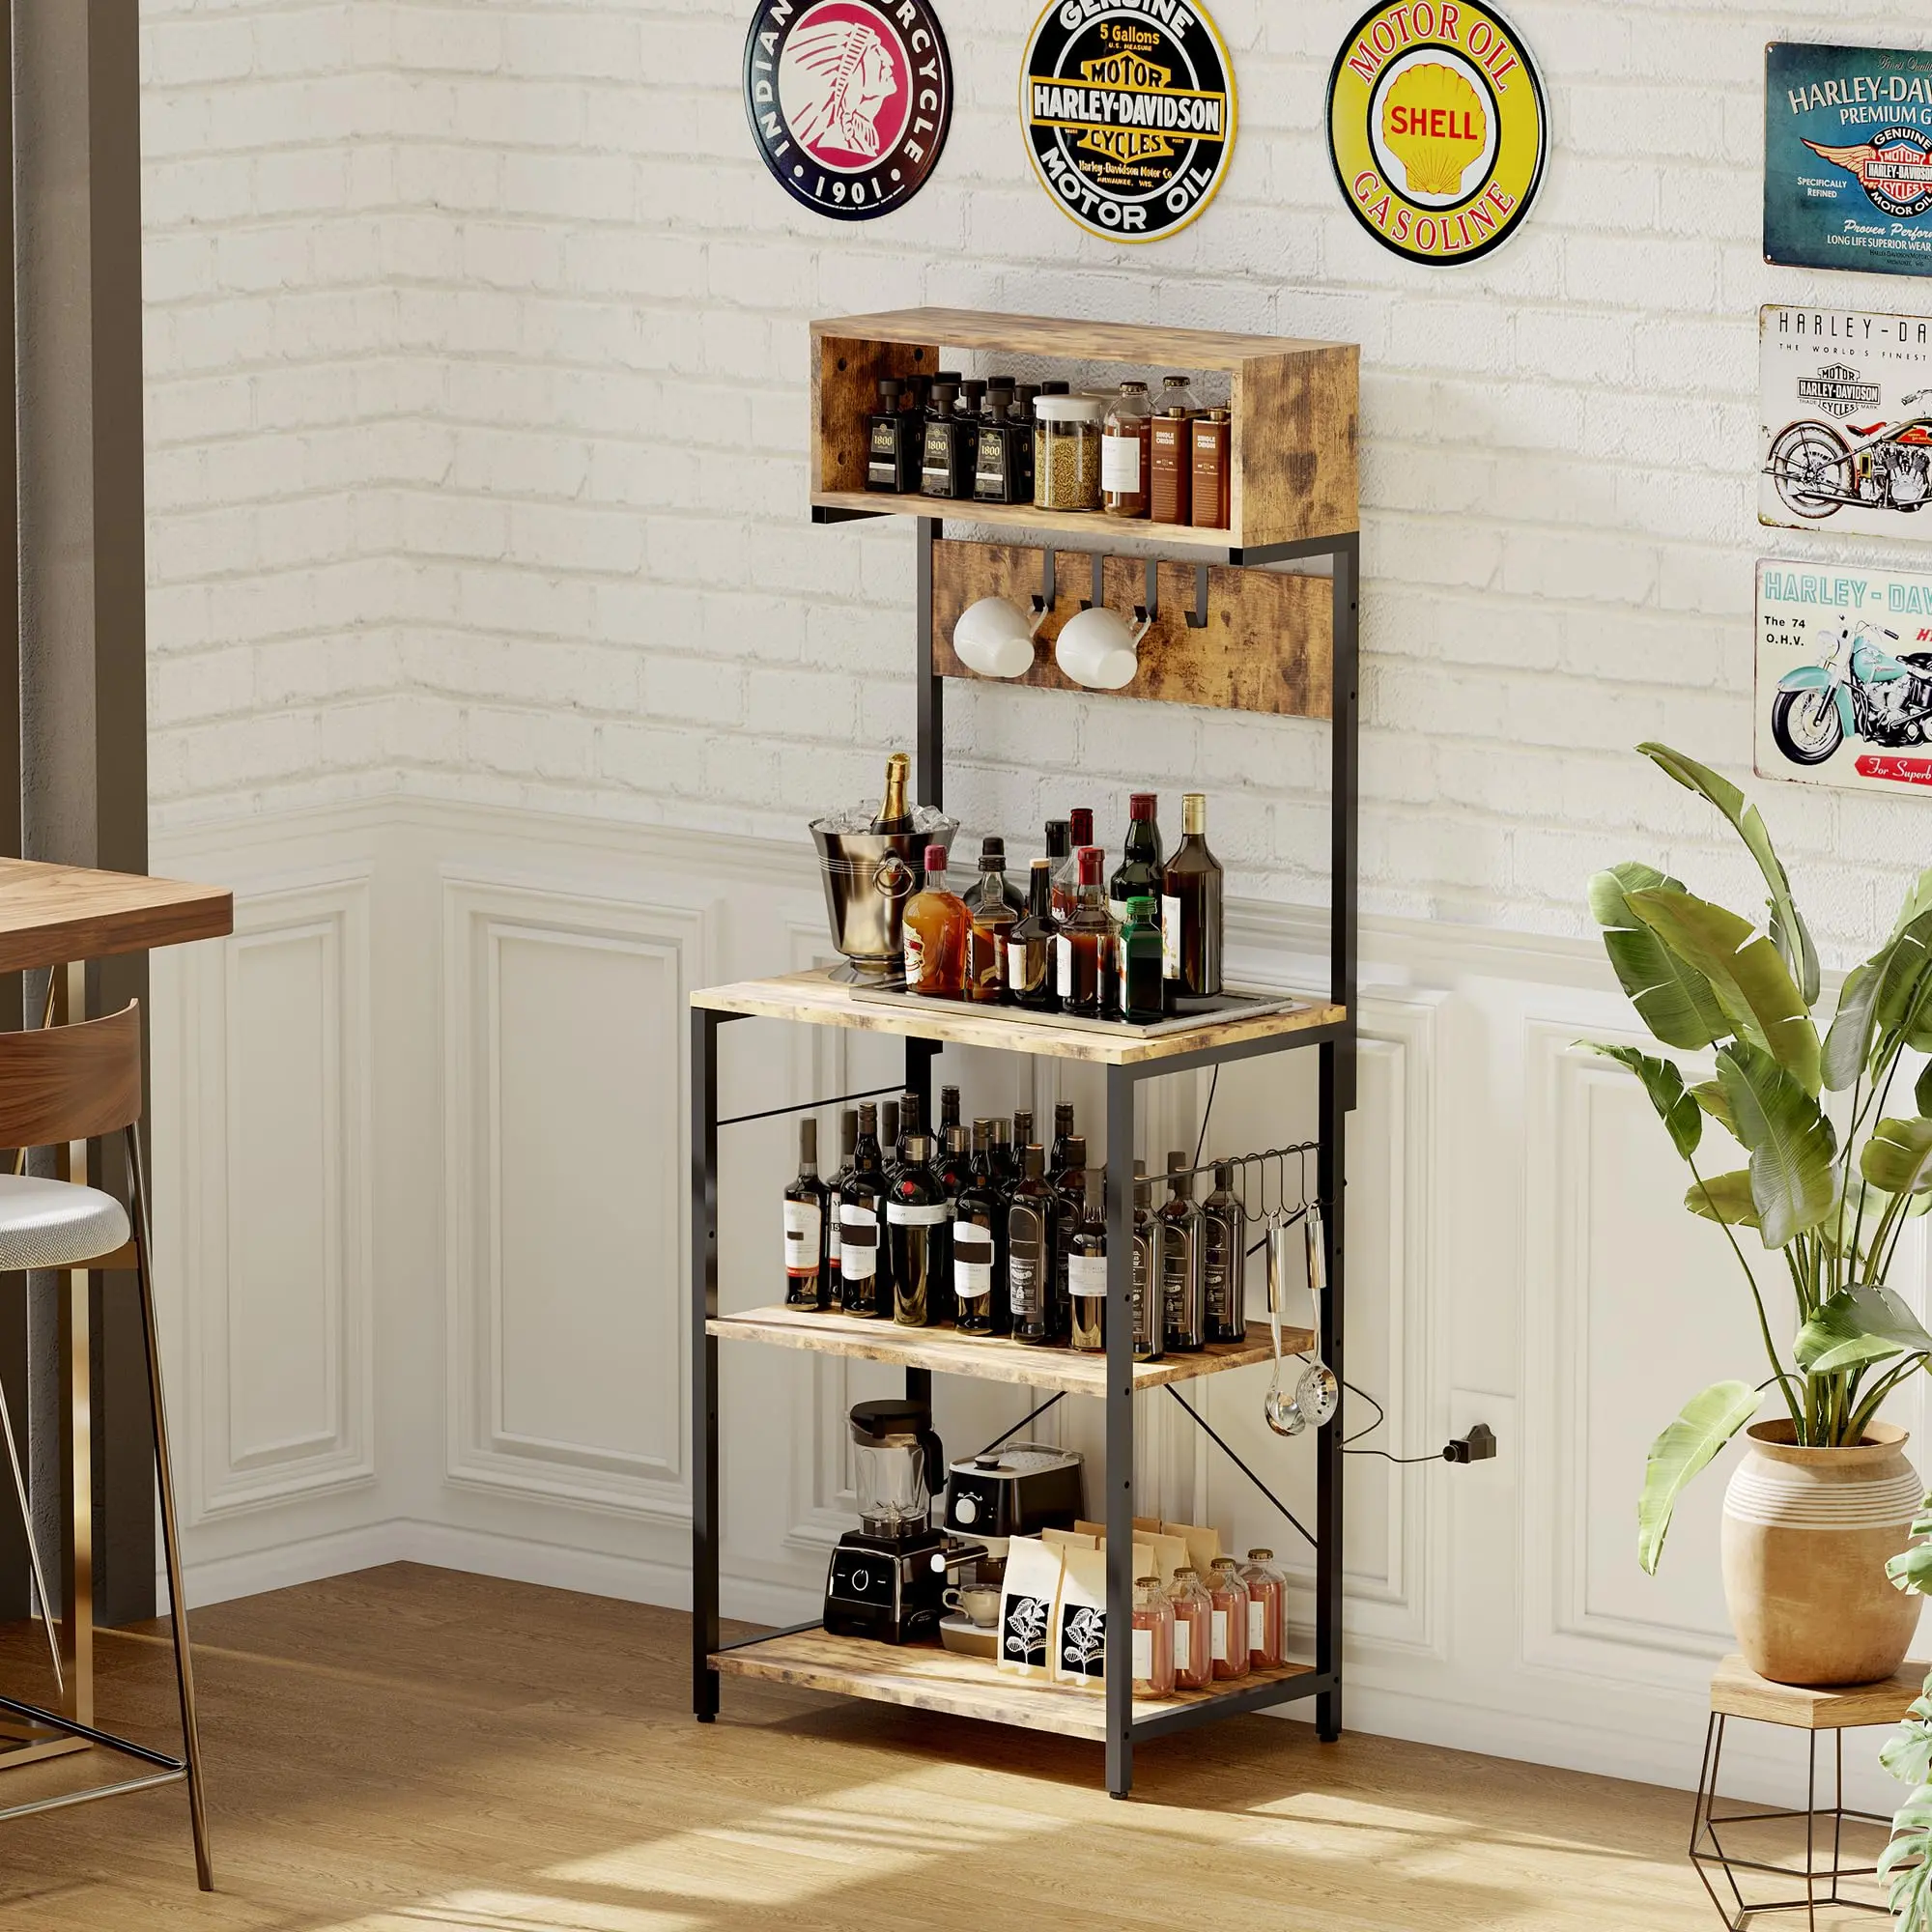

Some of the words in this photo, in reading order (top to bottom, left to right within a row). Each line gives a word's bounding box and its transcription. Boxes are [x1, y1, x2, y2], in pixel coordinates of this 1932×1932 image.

[1099, 23, 1108, 40] 5
[1112, 25, 1160, 44] Gallons
[1348, 1, 1460, 85] MOTOR
[1467, 20, 1518, 94] OIL
[755, 0, 793, 157] INDIAN
[883, 0, 937, 163] RCYCLE
[1091, 56, 1163, 88] MOTOR
[1390, 105, 1478, 141] SHELL
[1839, 105, 1918, 126] PREMIUM
[1091, 129, 1161, 158] CYCLES
[1874, 128, 1932, 151] GENUINE
[1884, 146, 1920, 163] MOTOR
[1078, 159, 1139, 176] Harley-Davidson
[1140, 166, 1161, 178] Motor
[815, 176, 882, 204] 1901
[1040, 146, 1148, 231] MOTOR
[1166, 167, 1212, 213] OIL
[1797, 176, 1847, 189] SPECIFICALLY
[1883, 182, 1919, 200] CYCLES
[1807, 187, 1837, 198] REFINED
[1353, 170, 1517, 252] GASOLINE
[1870, 191, 1913, 215] MOTOR
[1843, 219, 1887, 235] Proven
[1827, 235, 1851, 245] LONG
[1851, 236, 1867, 247] LIFE
[1867, 238, 1908, 250] SUPERIOR
[1908, 241, 1932, 252] WEAR
[1812, 346, 1869, 356] WORLDS
[1882, 351, 1926, 361] FINEST
[1821, 366, 1856, 382] MOTOR
[1821, 401, 1856, 416] CYCLES
[873, 435, 893, 446] 1800
[926, 440, 947, 451] 1800
[980, 444, 1000, 456] 1800
[1764, 615, 1785, 627] The
[1791, 617, 1805, 629] 74
[1766, 633, 1804, 646] O.H.V.
[1866, 757, 1889, 775] For
[1892, 760, 1932, 782] Superb
